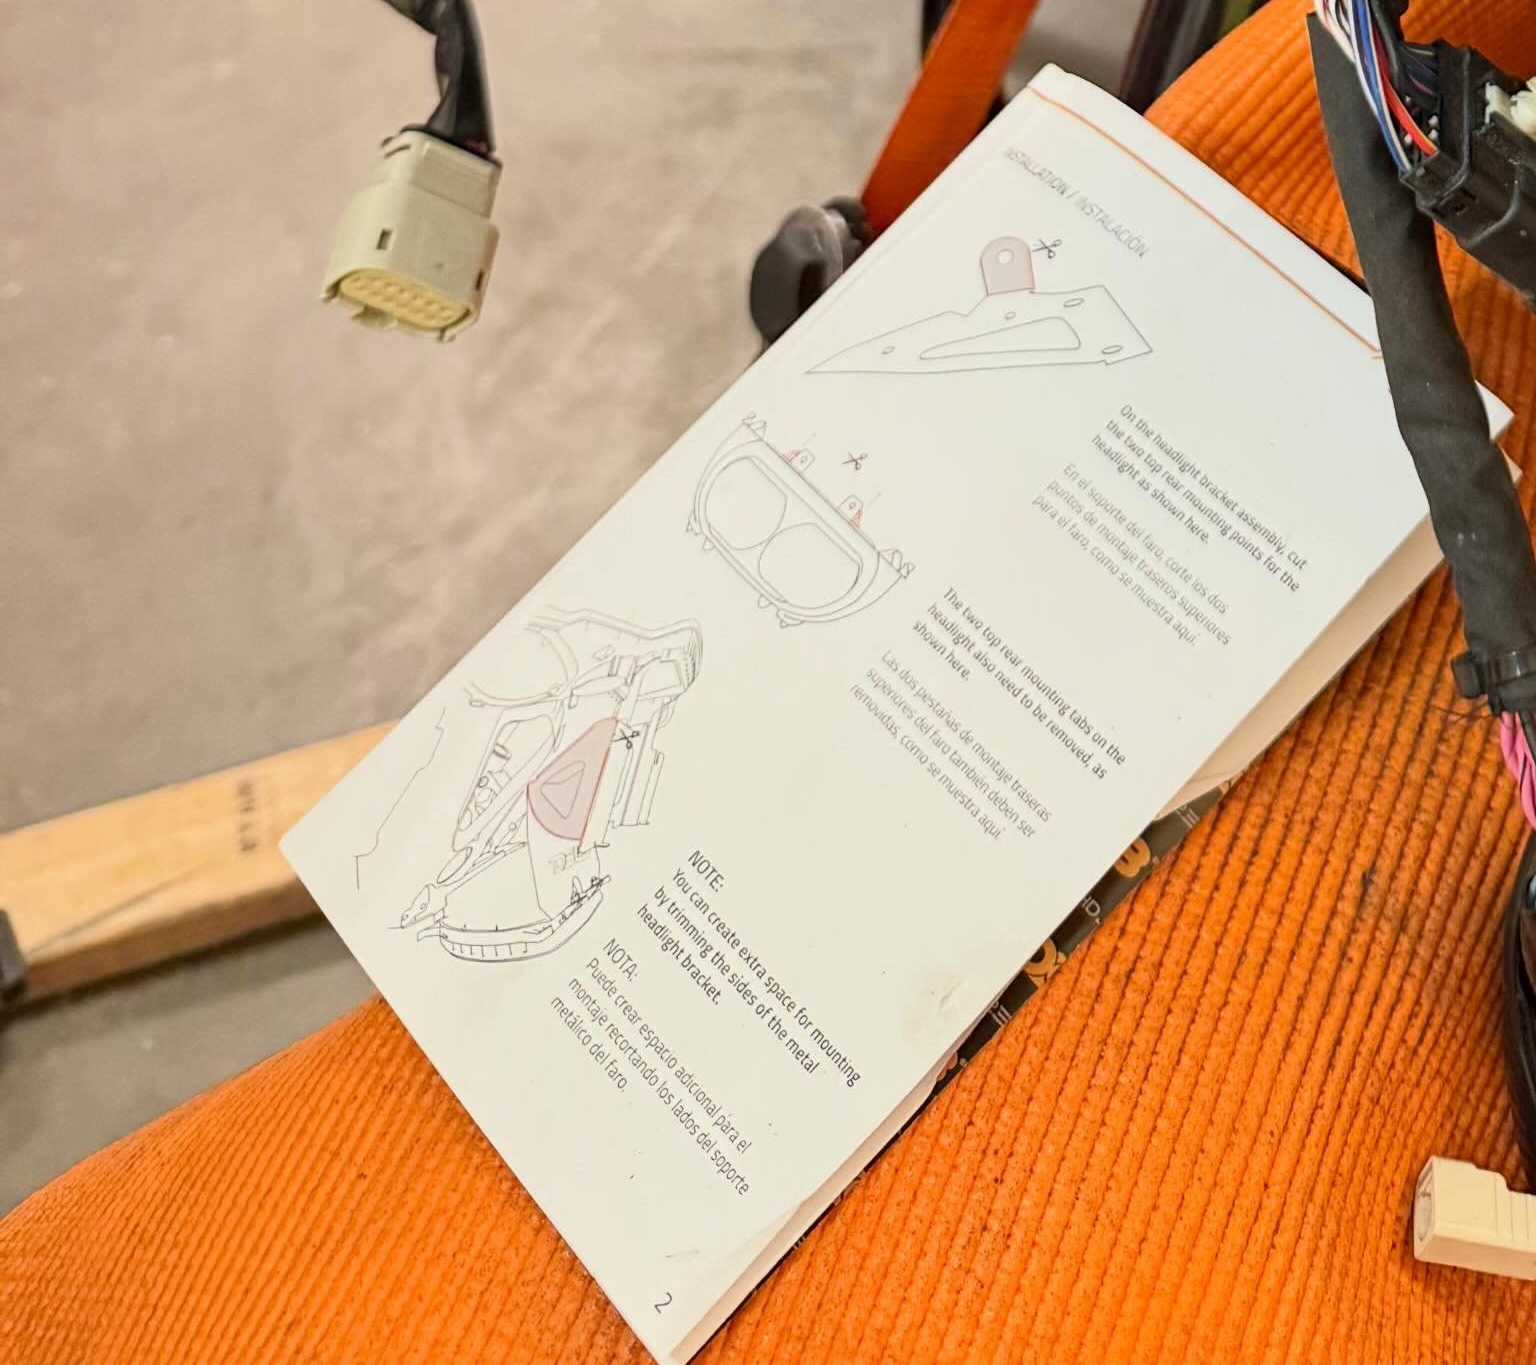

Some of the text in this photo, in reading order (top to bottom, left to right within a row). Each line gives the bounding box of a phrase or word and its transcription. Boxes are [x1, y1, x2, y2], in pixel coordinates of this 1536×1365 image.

[1046, 480, 1231, 645] puntos de montaje traseros superiores
[1064, 463, 1080, 481] En
[1077, 478, 1092, 490] el
[1088, 487, 1127, 525] soporte
[1126, 522, 1144, 539] del
[1165, 557, 1192, 583] corte
[1191, 578, 1209, 597] los
[1208, 595, 1228, 614] dos
[1092, 434, 1208, 544] headlight as shown here.
[1106, 420, 1299, 592] the two top rear mounting points for the
[1120, 405, 1307, 570] On the headlight bracket assembly, cut
[913, 621, 970, 680] shown here.
[928, 603, 1107, 779] headlight also need to be removed, as
[944, 587, 1125, 765] The two top rear mounting tabs on the
[866, 669, 1035, 837] superiores del faro también deben ser
[881, 650, 1051, 822] Las dos pestañas de montaje traseras
[688, 850, 724, 892] NOTE:
[603, 938, 637, 981] NOTA:
[637, 904, 721, 1005] headlight bracket.
[654, 885, 820, 1073] by trimming the sides of the metal
[673, 868, 861, 1087] You can create extra space for mounting
[551, 997, 627, 1092] metálico del faro.
[569, 979, 749, 1195] montaje recortando los lados del soporte
[586, 958, 752, 1154] Puede crear espacio adicional para el
[653, 1291, 672, 1314] 2
